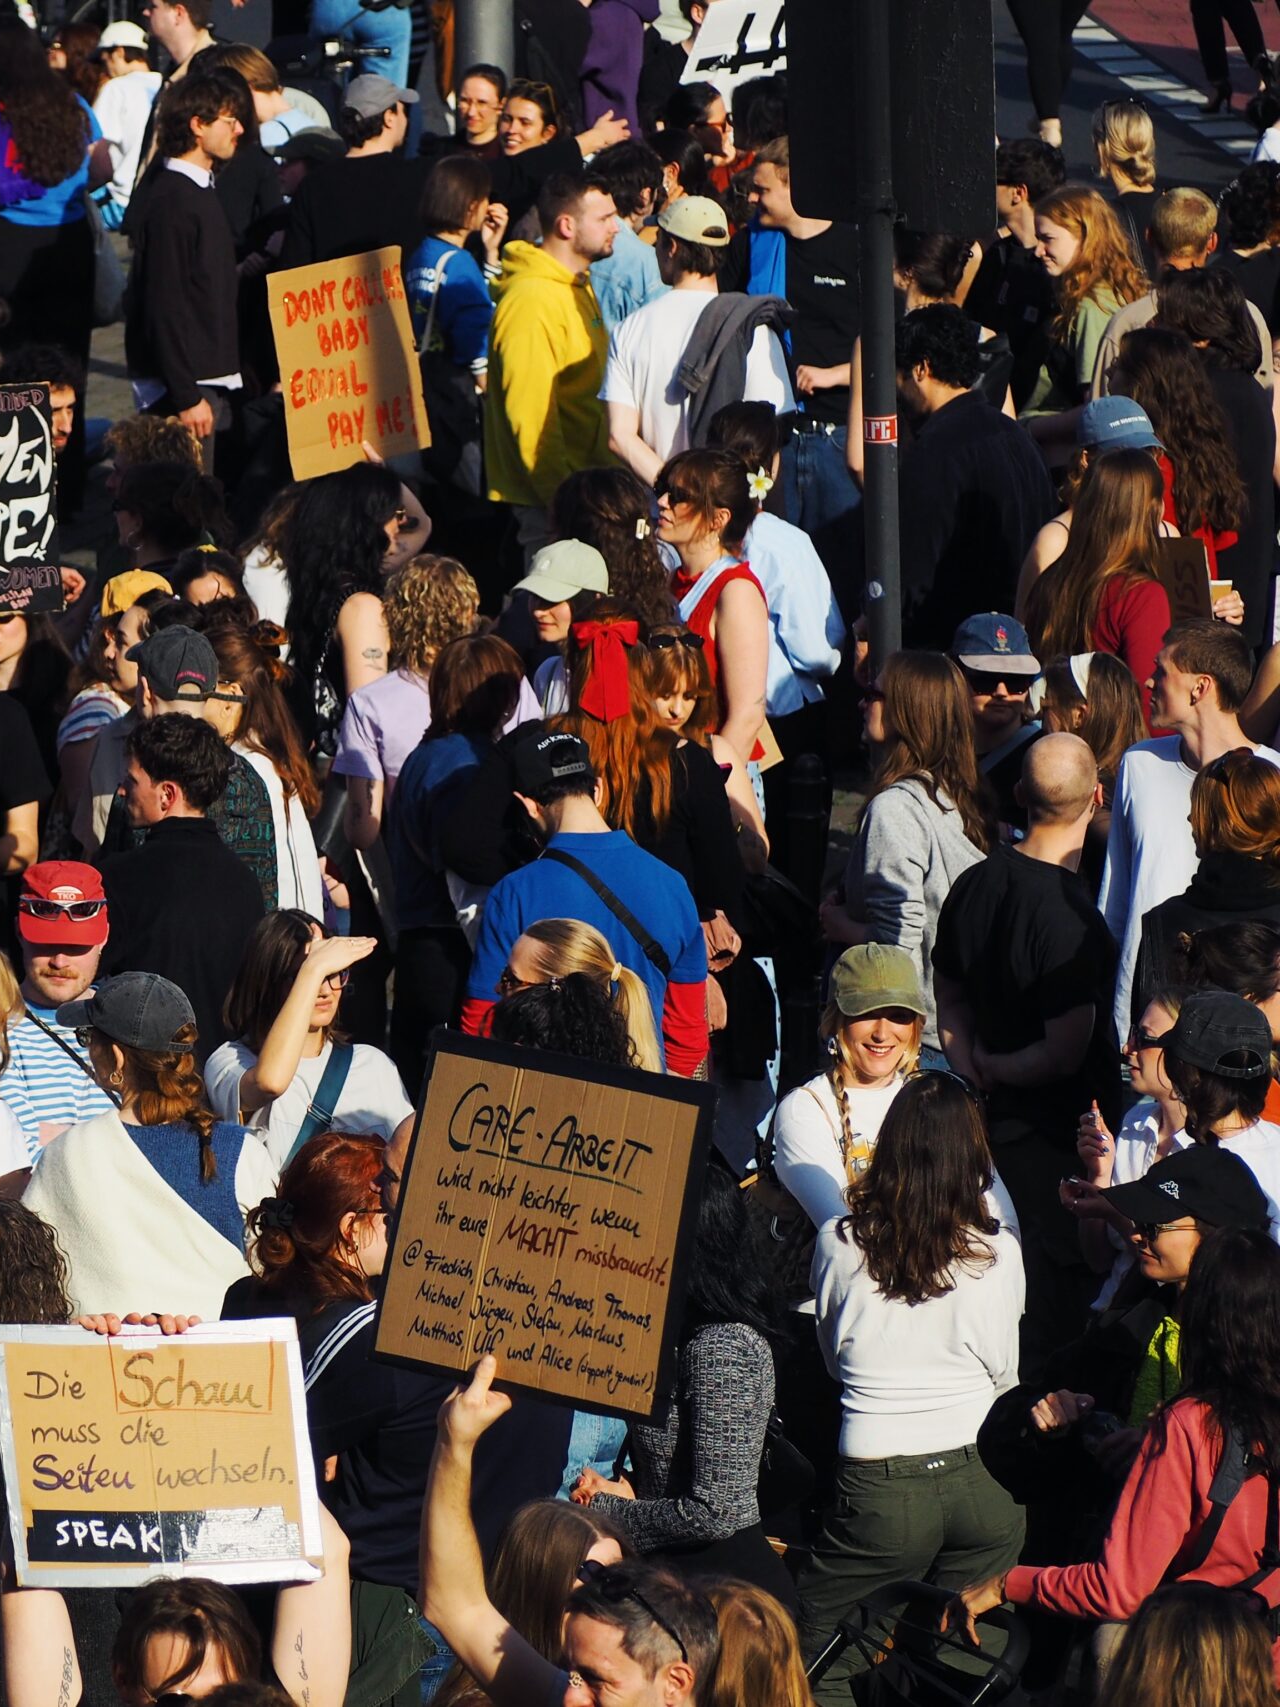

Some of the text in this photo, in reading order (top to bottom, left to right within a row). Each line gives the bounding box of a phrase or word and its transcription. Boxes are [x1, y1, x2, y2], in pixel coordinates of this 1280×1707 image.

[282, 279, 337, 328] DONT
[341, 276, 384, 312] CALL
[316, 315, 370, 358] BABY
[289, 360, 369, 411] EQUAL
[327, 405, 366, 450] PAY
[549, 733, 581, 744] JORDN
[437, 1163, 642, 1239] wird nicht leichter, wenn
[435, 1200, 670, 1288] ihr eure MACHT missbraucht.
[403, 1238, 653, 1334] @ Friedrich, Christian, Andreas, Thomas,
[416, 1279, 627, 1353] Michael, Jürgen, Stefan, Markus,
[407, 1314, 465, 1353] Matthias,
[473, 1328, 506, 1356] Ulf
[506, 1342, 535, 1363] und
[538, 1344, 574, 1372] Alice
[23, 1351, 264, 1410] Die Scham
[31, 1415, 170, 1447] muss die
[32, 1446, 295, 1494] Seiten wechseln.
[56, 1519, 163, 1554] SPEAK
